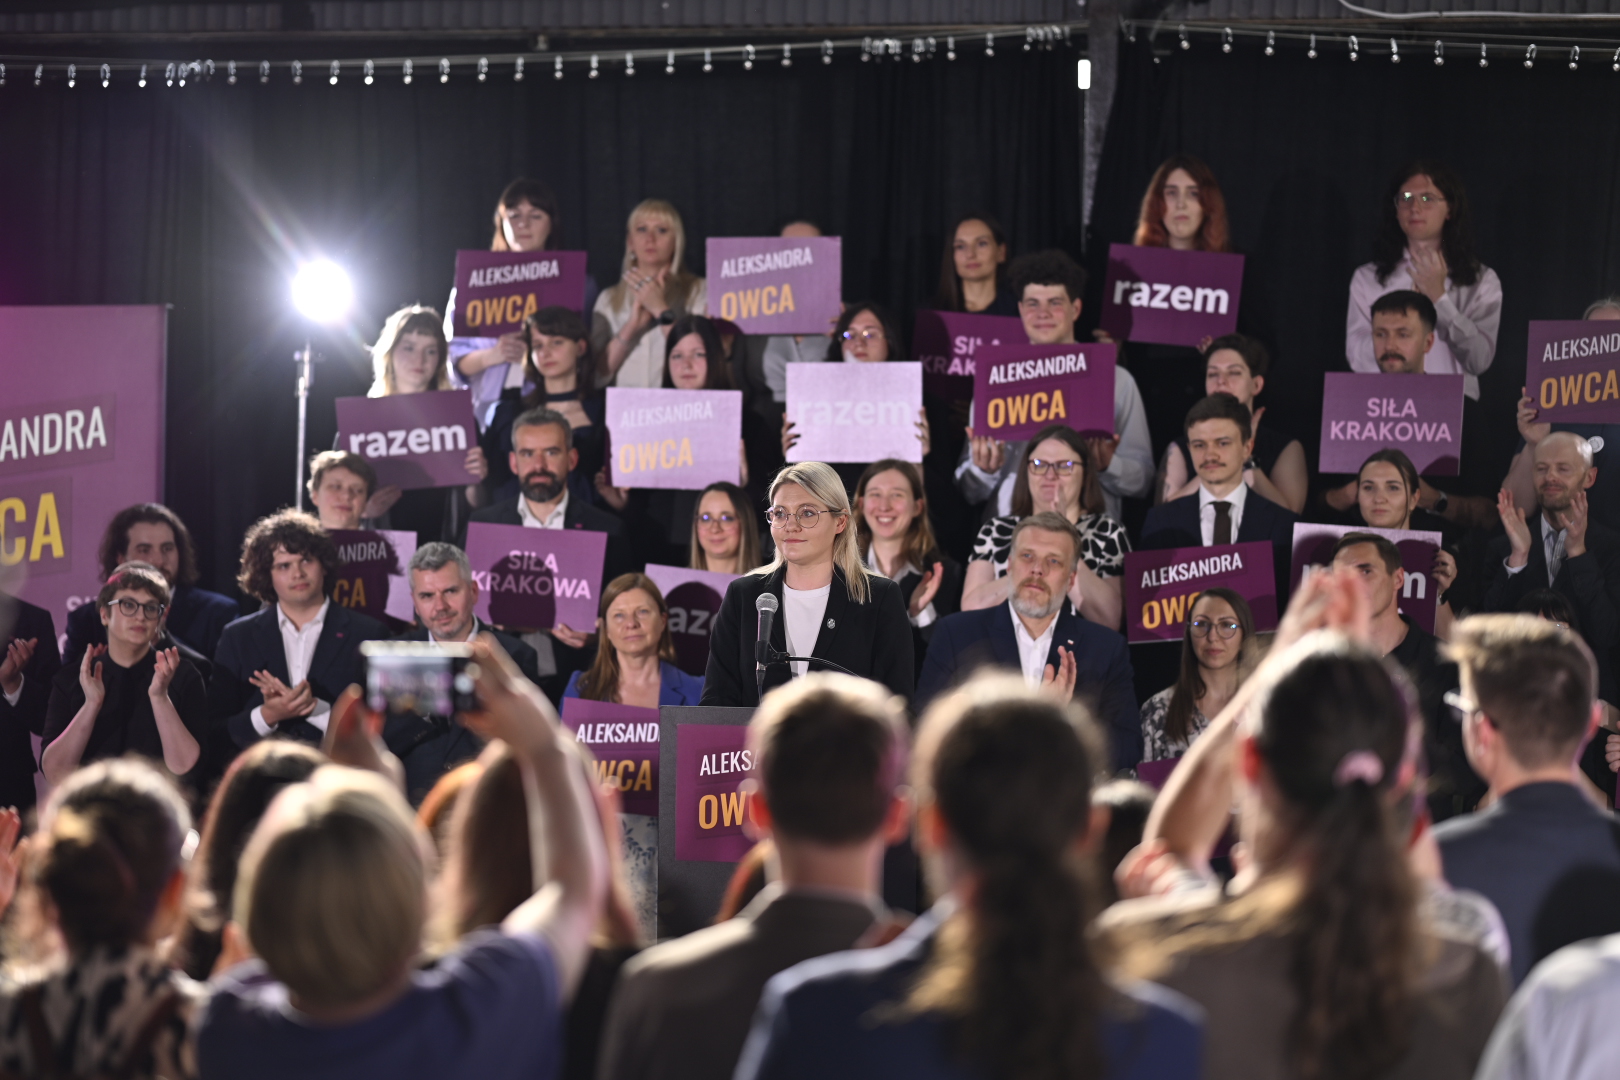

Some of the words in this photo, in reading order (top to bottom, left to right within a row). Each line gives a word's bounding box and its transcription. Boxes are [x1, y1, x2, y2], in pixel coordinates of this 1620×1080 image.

[469, 259, 560, 288] ALEKSANDRA
[721, 246, 813, 279] ALEKSANDRA
[466, 293, 538, 327] OWCA
[721, 284, 795, 321] OWCA
[1113, 279, 1230, 315] razem
[919, 355, 976, 376] KRAK
[989, 352, 1087, 385] ALEKSANDRA
[1540, 369, 1619, 409] OWCA
[619, 401, 713, 429] ALEKSANDRA
[797, 400, 911, 428] razem
[987, 389, 1066, 429] OWCA
[1367, 397, 1418, 418] SIŁA
[349, 424, 467, 458] razem
[1330, 420, 1452, 443] KRAKOWA
[619, 437, 693, 474] OWCA
[338, 541, 387, 562] ANDRA
[508, 550, 558, 573] SIŁA
[471, 570, 591, 600] KRAKOWA
[1141, 552, 1243, 588] ALEKSANDRA
[333, 577, 367, 608] CA
[1142, 591, 1201, 629] OW
[575, 722, 660, 743] ALEKSAND
[592, 759, 652, 791] WCA
[699, 749, 759, 776] ALEKS
[699, 791, 747, 830] OW
